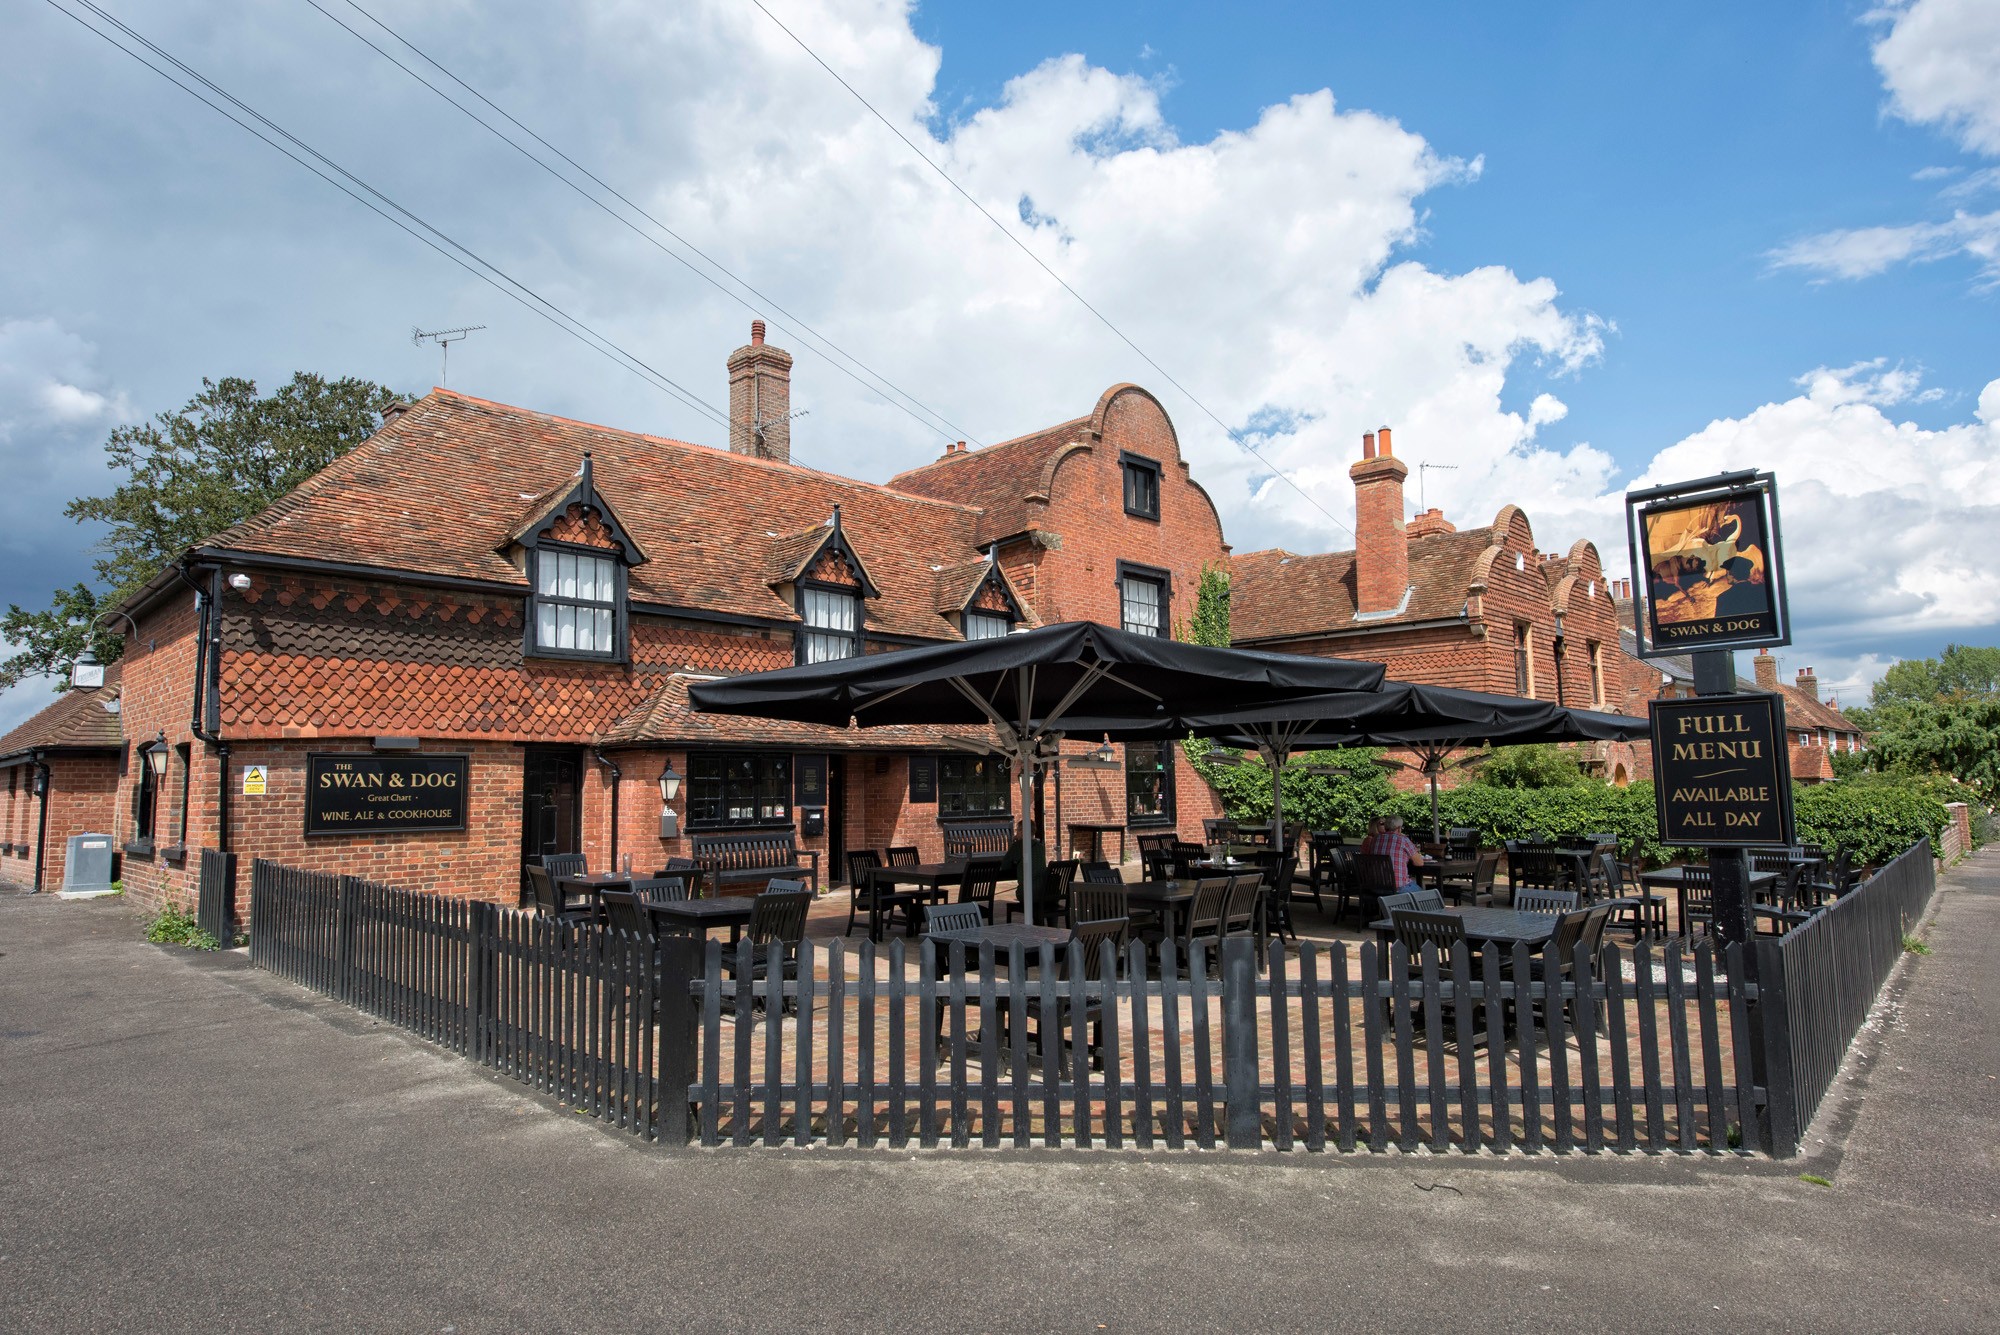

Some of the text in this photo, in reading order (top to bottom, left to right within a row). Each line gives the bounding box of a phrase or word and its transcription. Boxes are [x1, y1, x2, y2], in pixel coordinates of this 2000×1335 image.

[1670, 624, 1709, 637] SWAN
[1712, 622, 1724, 633] &
[1727, 618, 1760, 632] DOG
[1678, 714, 1750, 735] FULL
[1672, 740, 1762, 761] MENU
[320, 772, 456, 789] SWAN & DOG
[367, 793, 412, 802] Great Chart
[1672, 786, 1769, 802] AVAILABLE
[322, 809, 452, 821] WINE, ALE & COOKHOUSE
[1682, 811, 1762, 826] ALL DAY
